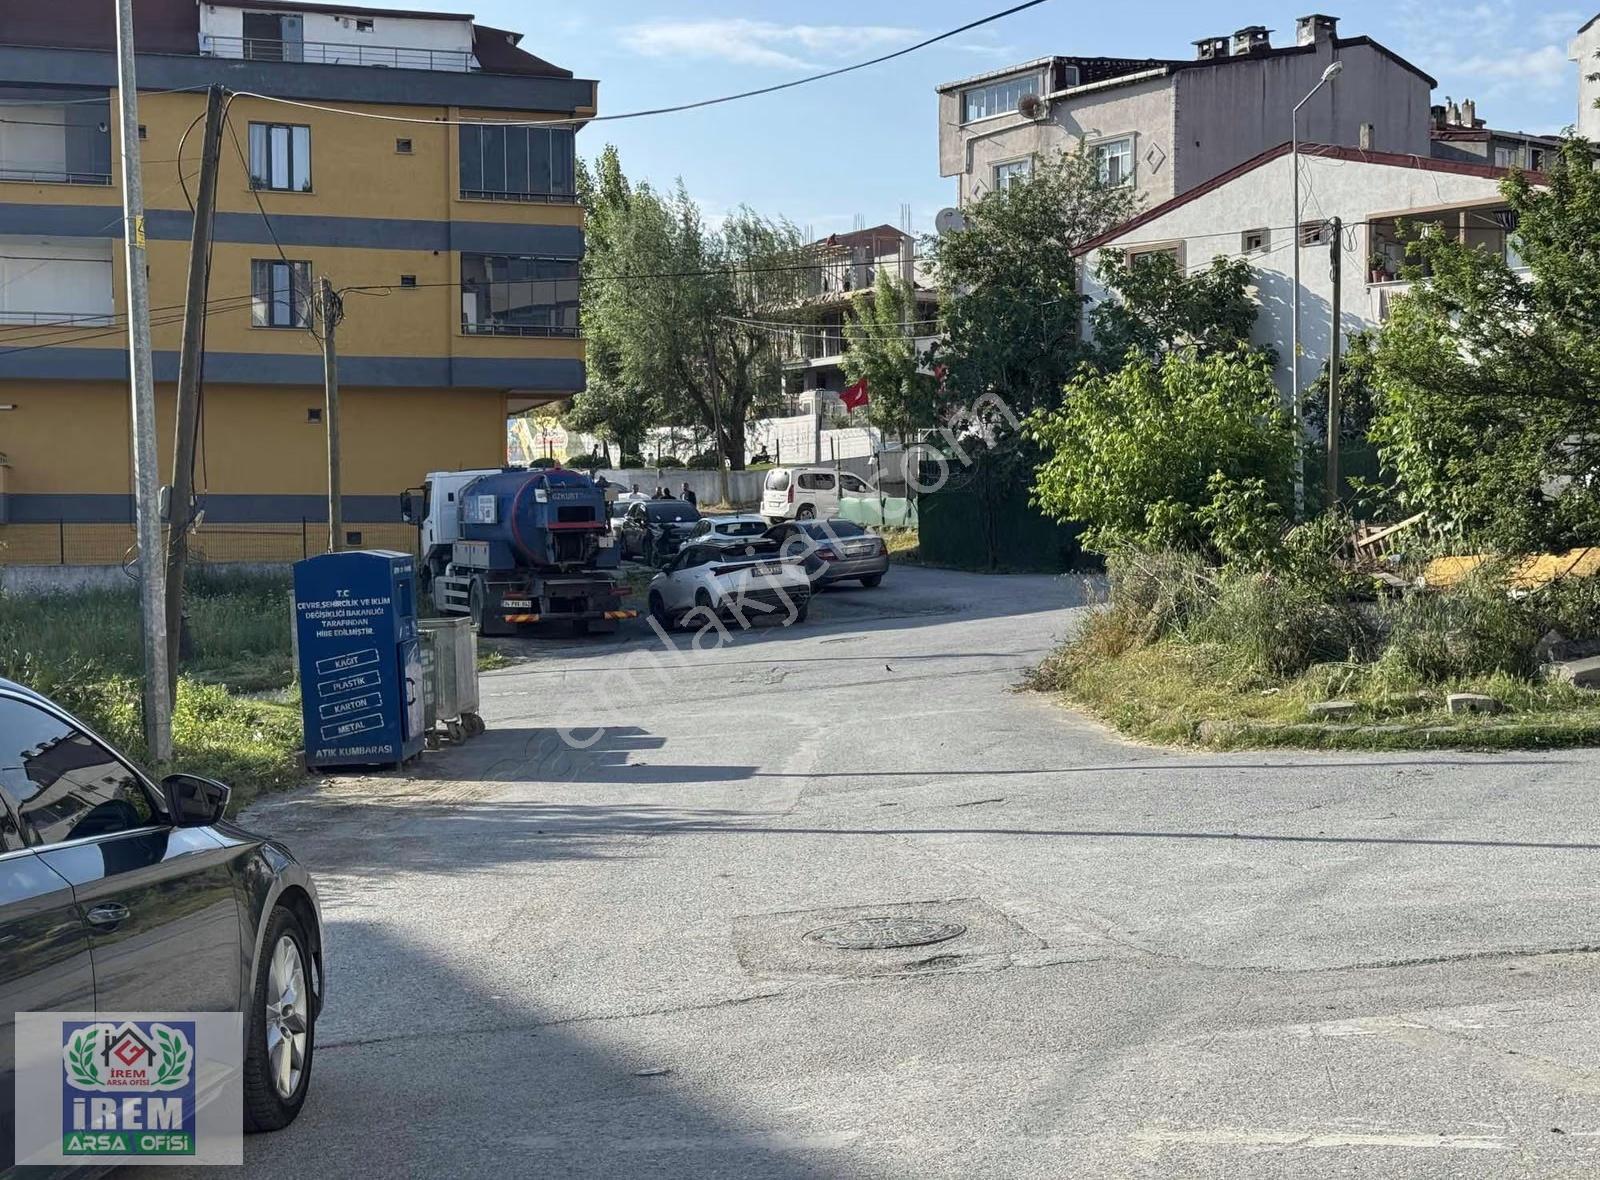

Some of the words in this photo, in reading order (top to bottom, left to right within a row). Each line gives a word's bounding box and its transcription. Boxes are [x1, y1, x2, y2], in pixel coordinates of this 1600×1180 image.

[361, 598, 370, 606] VE
[321, 618, 368, 627] TARAFINDAN
[335, 656, 358, 668] KAĞIT
[334, 698, 367, 713] KARTON
[338, 721, 366, 734] METAL
[315, 748, 337, 758] ATIK
[339, 744, 392, 757] KUMBARASI
